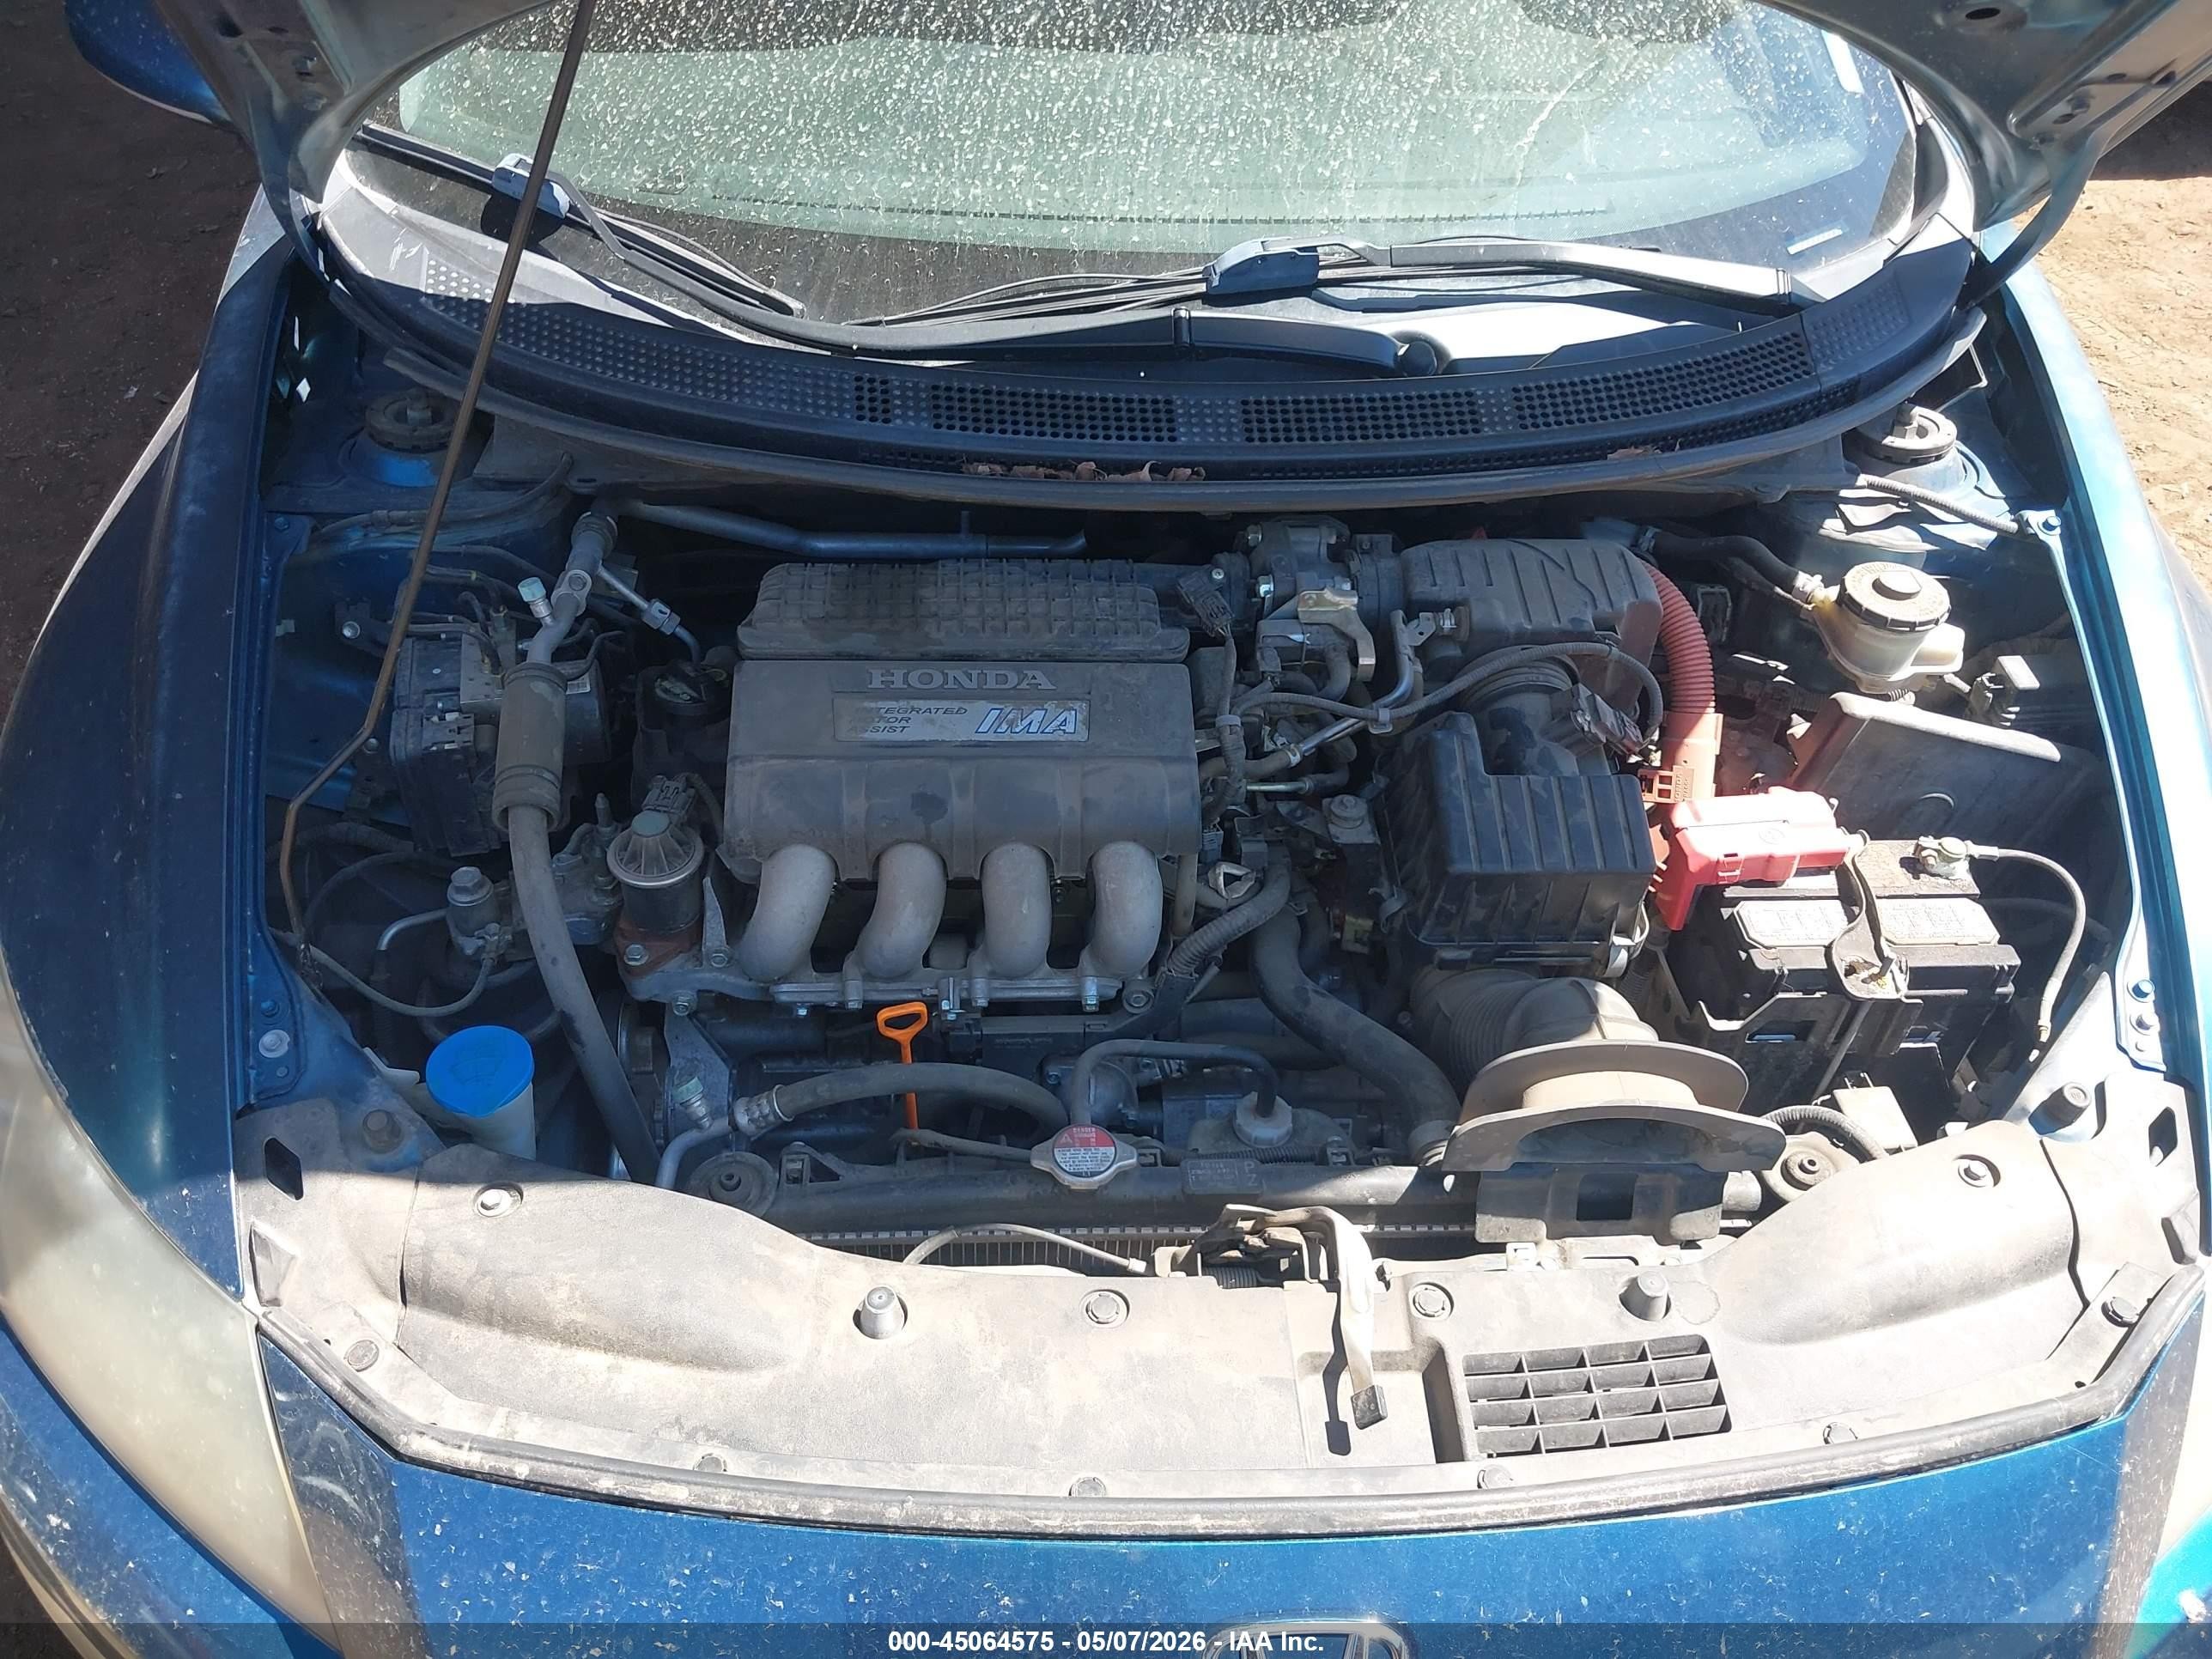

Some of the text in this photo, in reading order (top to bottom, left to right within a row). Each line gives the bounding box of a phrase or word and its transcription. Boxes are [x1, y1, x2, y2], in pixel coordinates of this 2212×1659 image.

[866, 668, 1057, 690] HONDA
[859, 706, 968, 715] TEGRATED
[860, 715, 912, 724] TOR
[975, 707, 1078, 735] IMA
[855, 725, 911, 734] SIST
